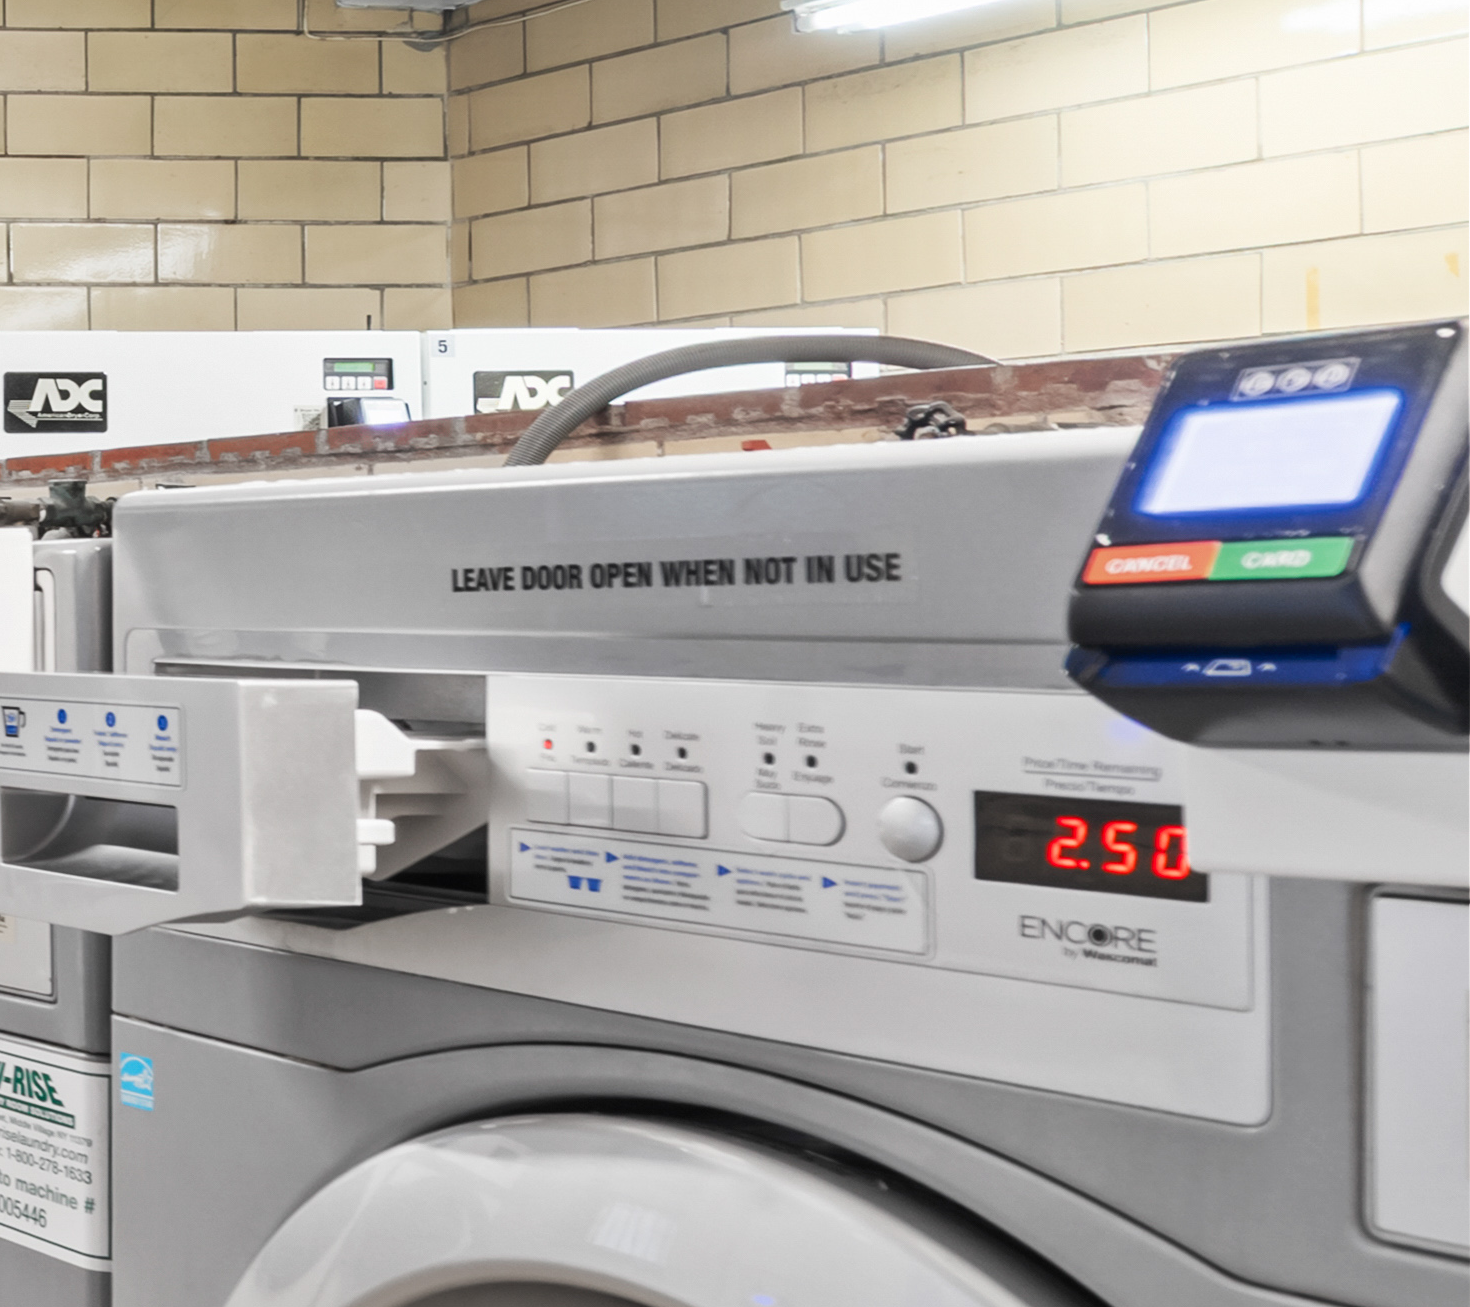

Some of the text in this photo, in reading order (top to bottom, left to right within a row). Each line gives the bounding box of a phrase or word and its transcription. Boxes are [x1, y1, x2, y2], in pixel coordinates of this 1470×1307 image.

[437, 339, 448, 354] 5
[26, 378, 103, 413] ADC
[451, 552, 902, 592] LEAVE DOOR OPEN WHEN NOT IN USE
[1103, 555, 1193, 575] CANCEL
[1093, 760, 1163, 779] Remaining
[1045, 814, 1192, 881] 2.50
[1019, 914, 1158, 954] ENCORE
[1081, 947, 1159, 968] Wascomat
[6, 1146, 93, 1186] 1-800-278-1633
[15, 1177, 80, 1211] machine
[84, 1197, 96, 1216] #
